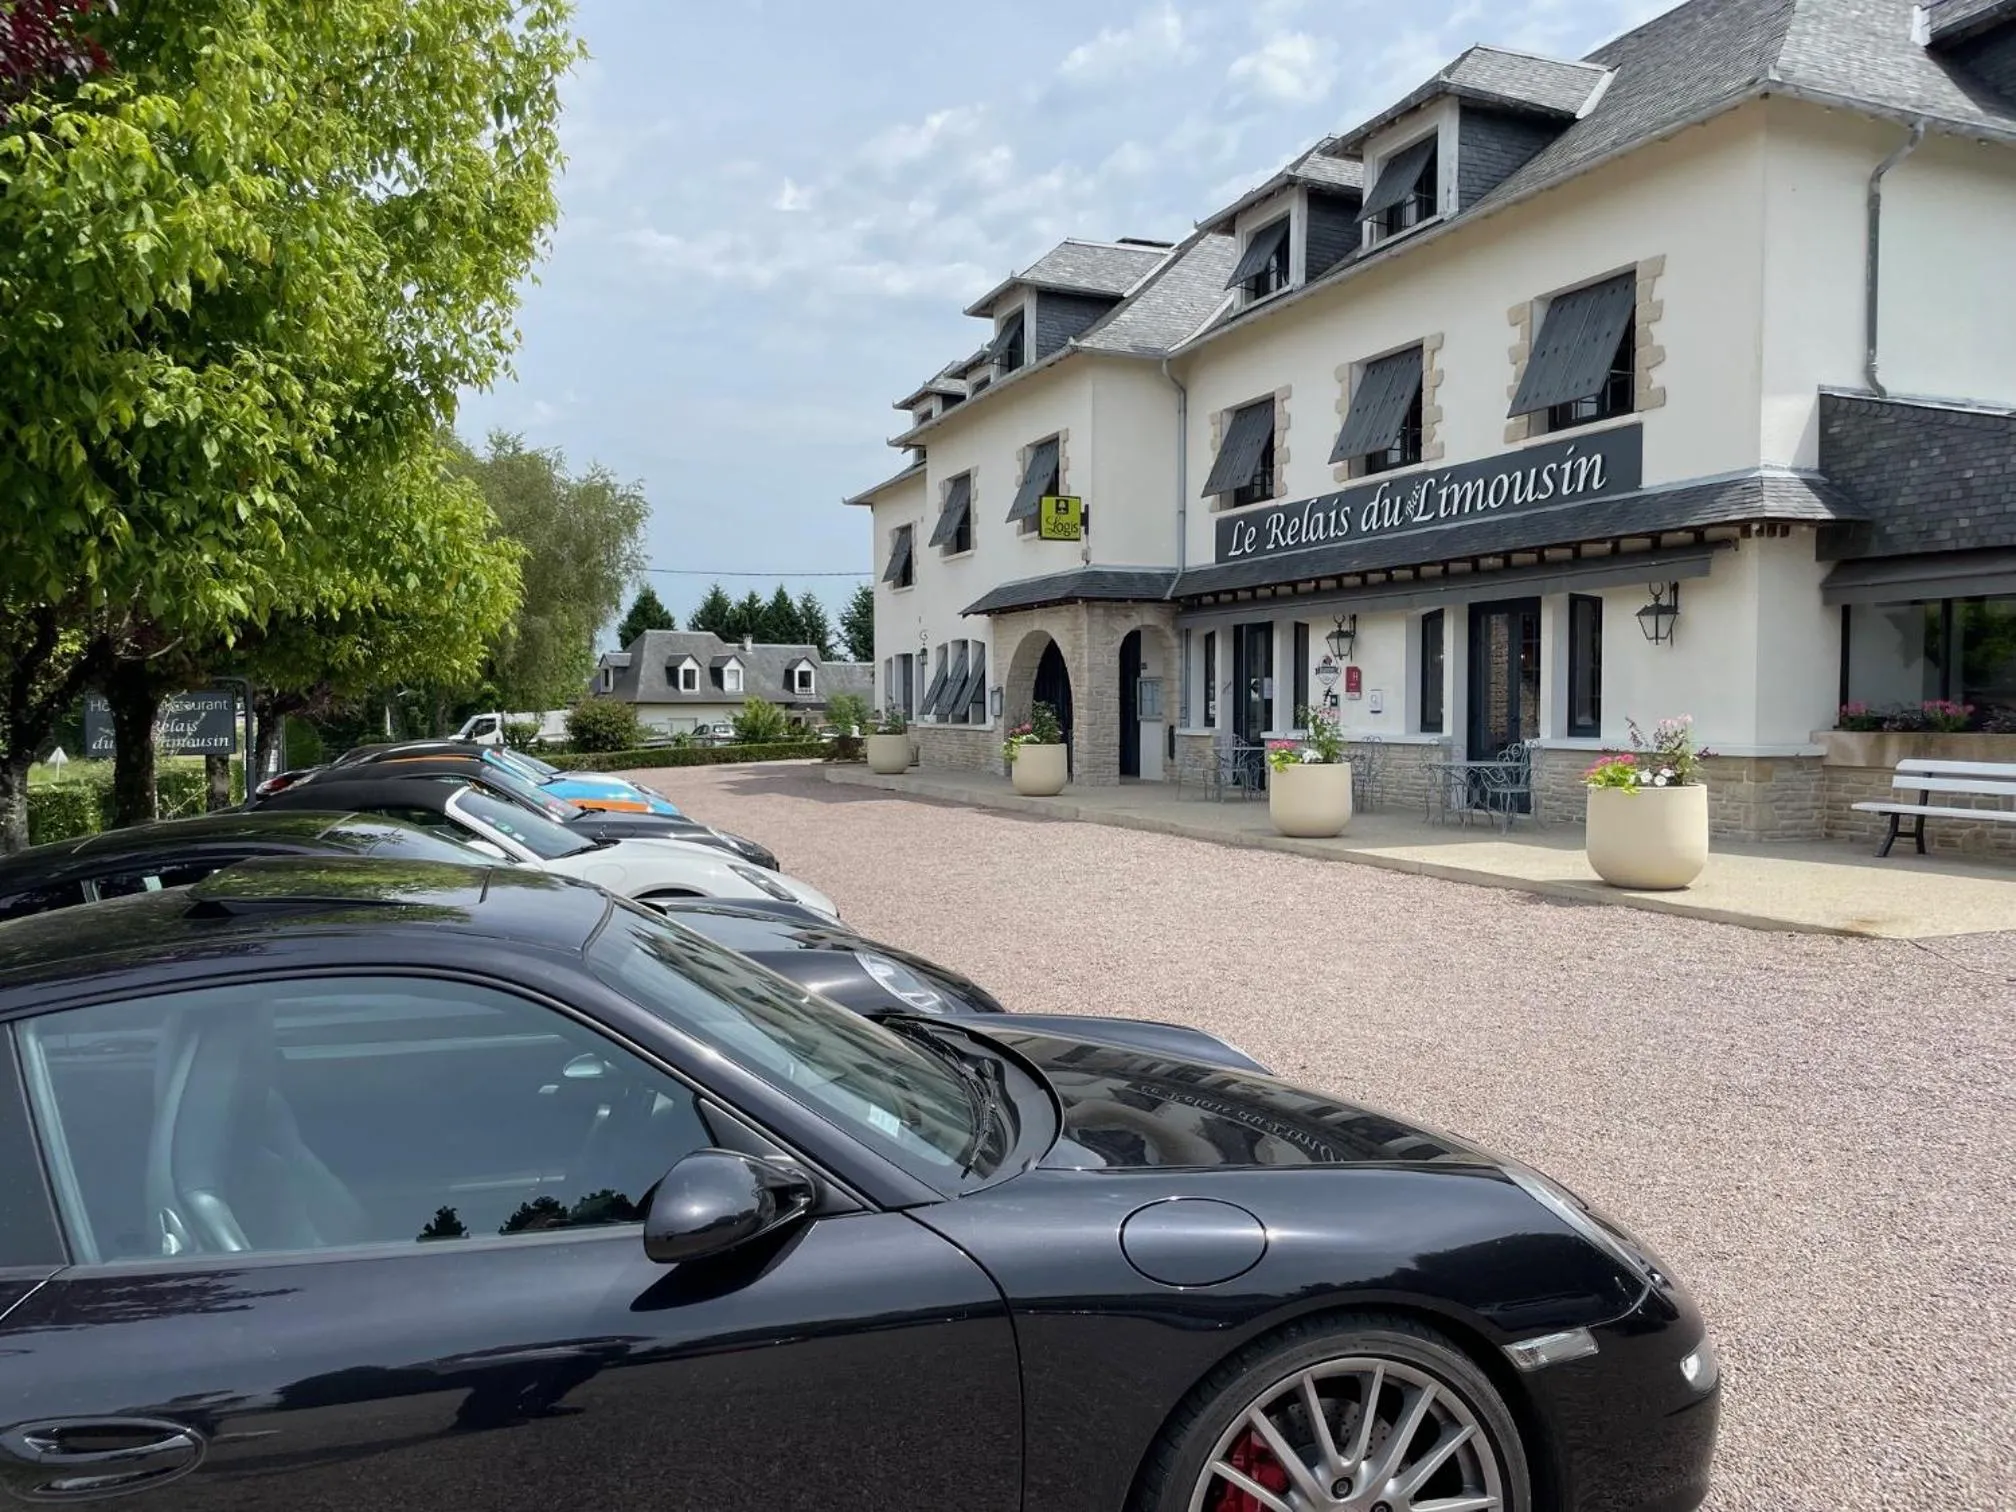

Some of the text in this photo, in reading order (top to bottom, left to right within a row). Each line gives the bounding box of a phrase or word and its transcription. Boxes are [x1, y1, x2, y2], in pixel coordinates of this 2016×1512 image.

[1227, 519, 1257, 557] Le
[1265, 497, 1352, 551] Relais
[1360, 480, 1404, 533] du
[1411, 443, 1608, 523] Limousin
